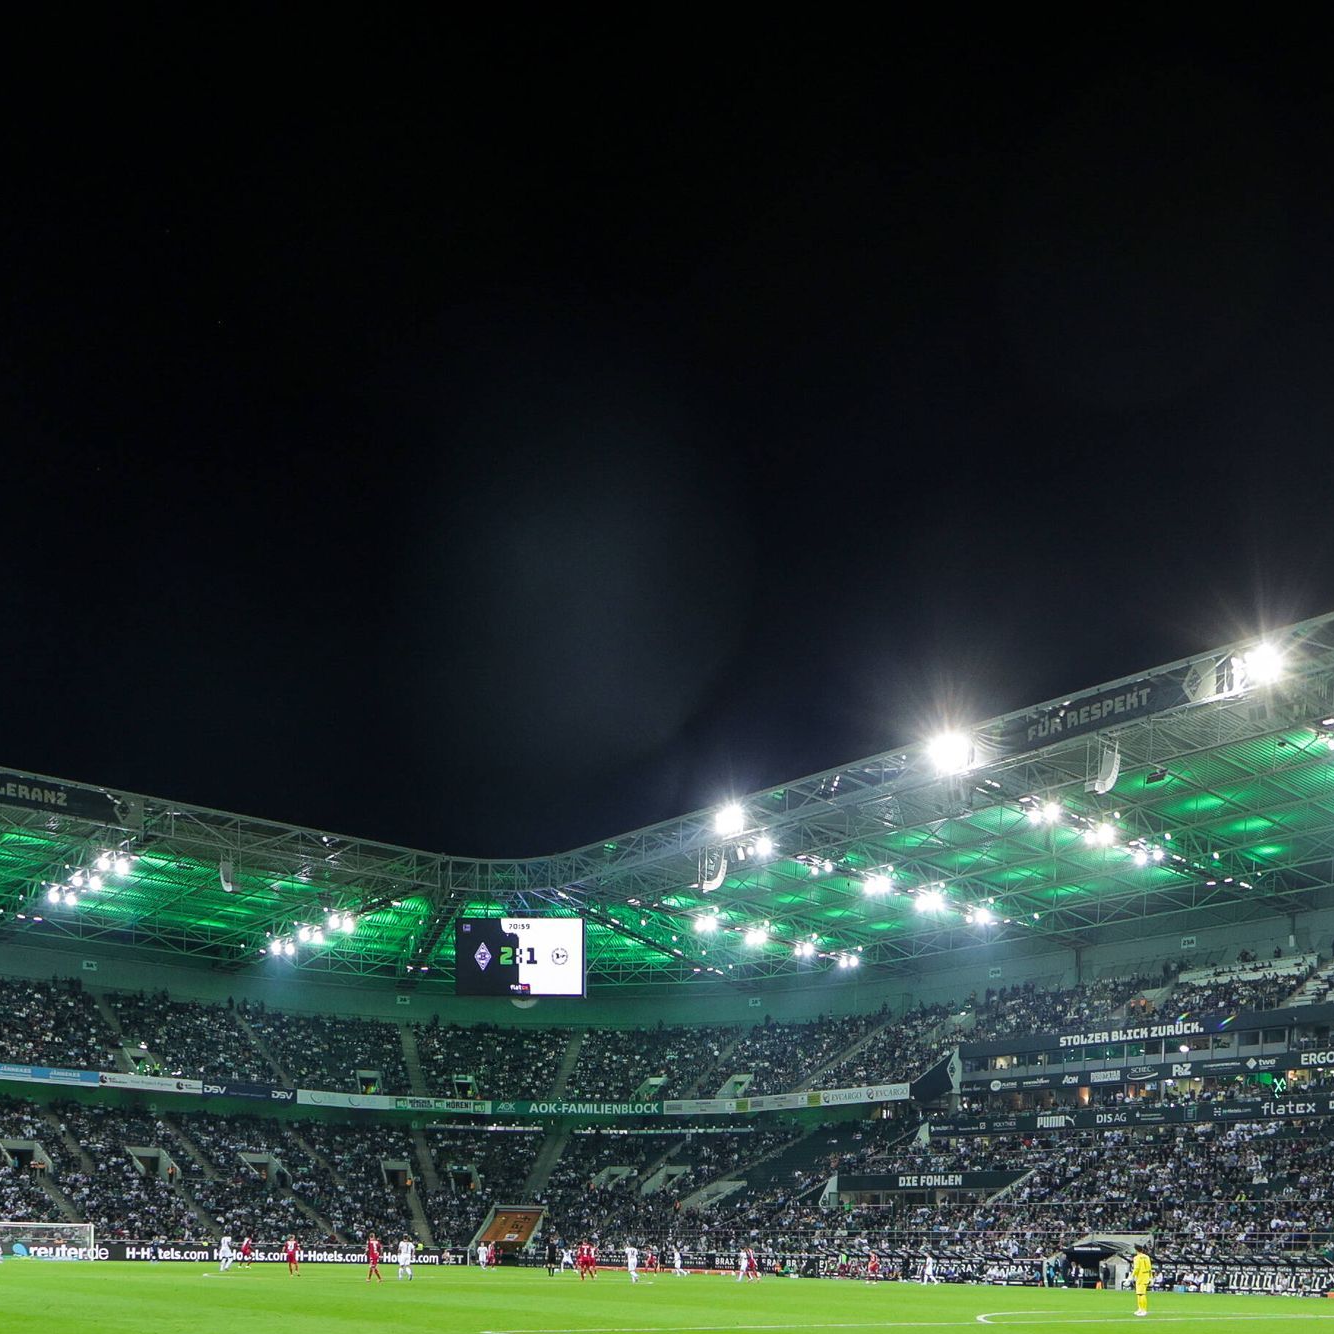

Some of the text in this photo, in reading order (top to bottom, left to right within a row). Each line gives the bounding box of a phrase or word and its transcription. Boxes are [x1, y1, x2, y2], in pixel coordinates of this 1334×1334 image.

[1027, 687, 1151, 743] FÜR RESPEKT
[1059, 1021, 1204, 1047] STOLZER BLICK ZURÜCK.
[204, 1084, 227, 1094] DSV
[271, 1090, 293, 1100] DSV
[529, 1102, 659, 1114] AOK-FAMILIENBLOCK
[1037, 1115, 1066, 1128] PUMA
[1096, 1112, 1127, 1123] DIS AG
[898, 1174, 963, 1187] DIE FOHLEN
[125, 1246, 209, 1260] H-Htels.com
[295, 1250, 368, 1262] H-Hotels.com
[714, 1257, 735, 1266] BRAX
